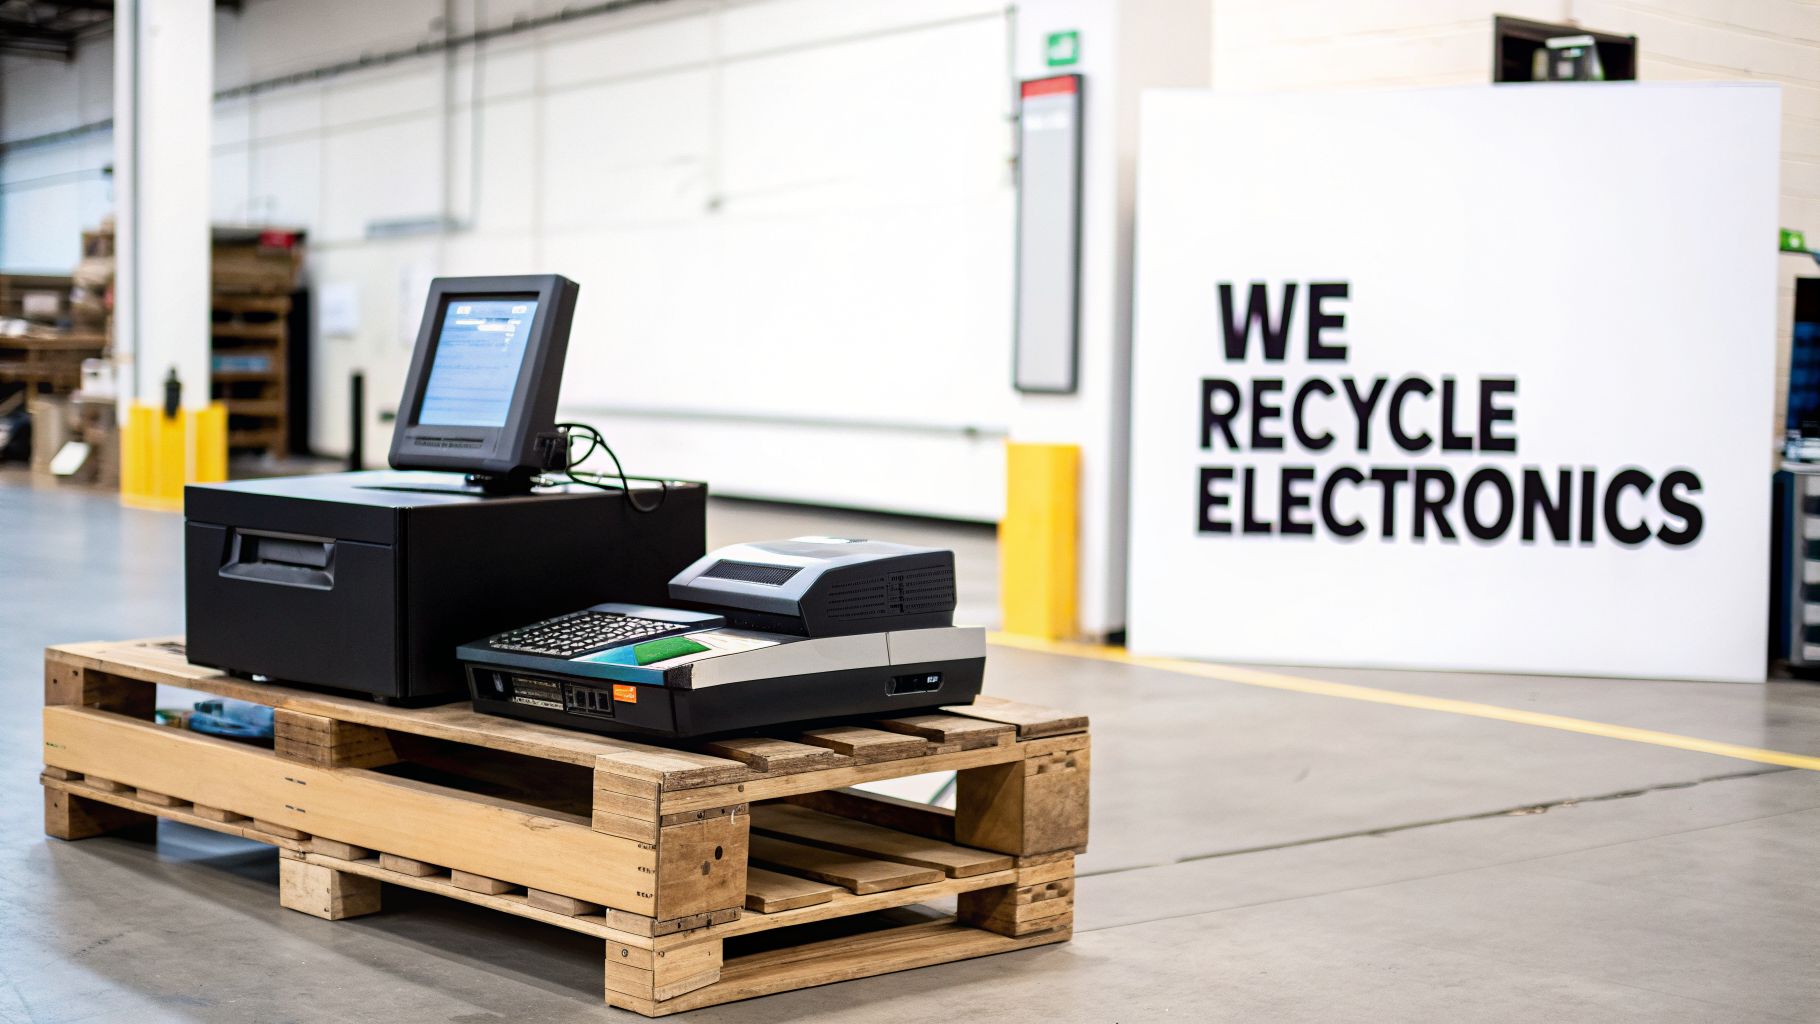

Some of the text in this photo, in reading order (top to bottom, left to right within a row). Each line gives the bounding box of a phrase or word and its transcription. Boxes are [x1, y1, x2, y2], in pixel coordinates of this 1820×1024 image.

[1218, 282, 1349, 361] WE
[1200, 377, 1517, 453] RECYCLE
[1198, 466, 1704, 546] ELECTRONICS
